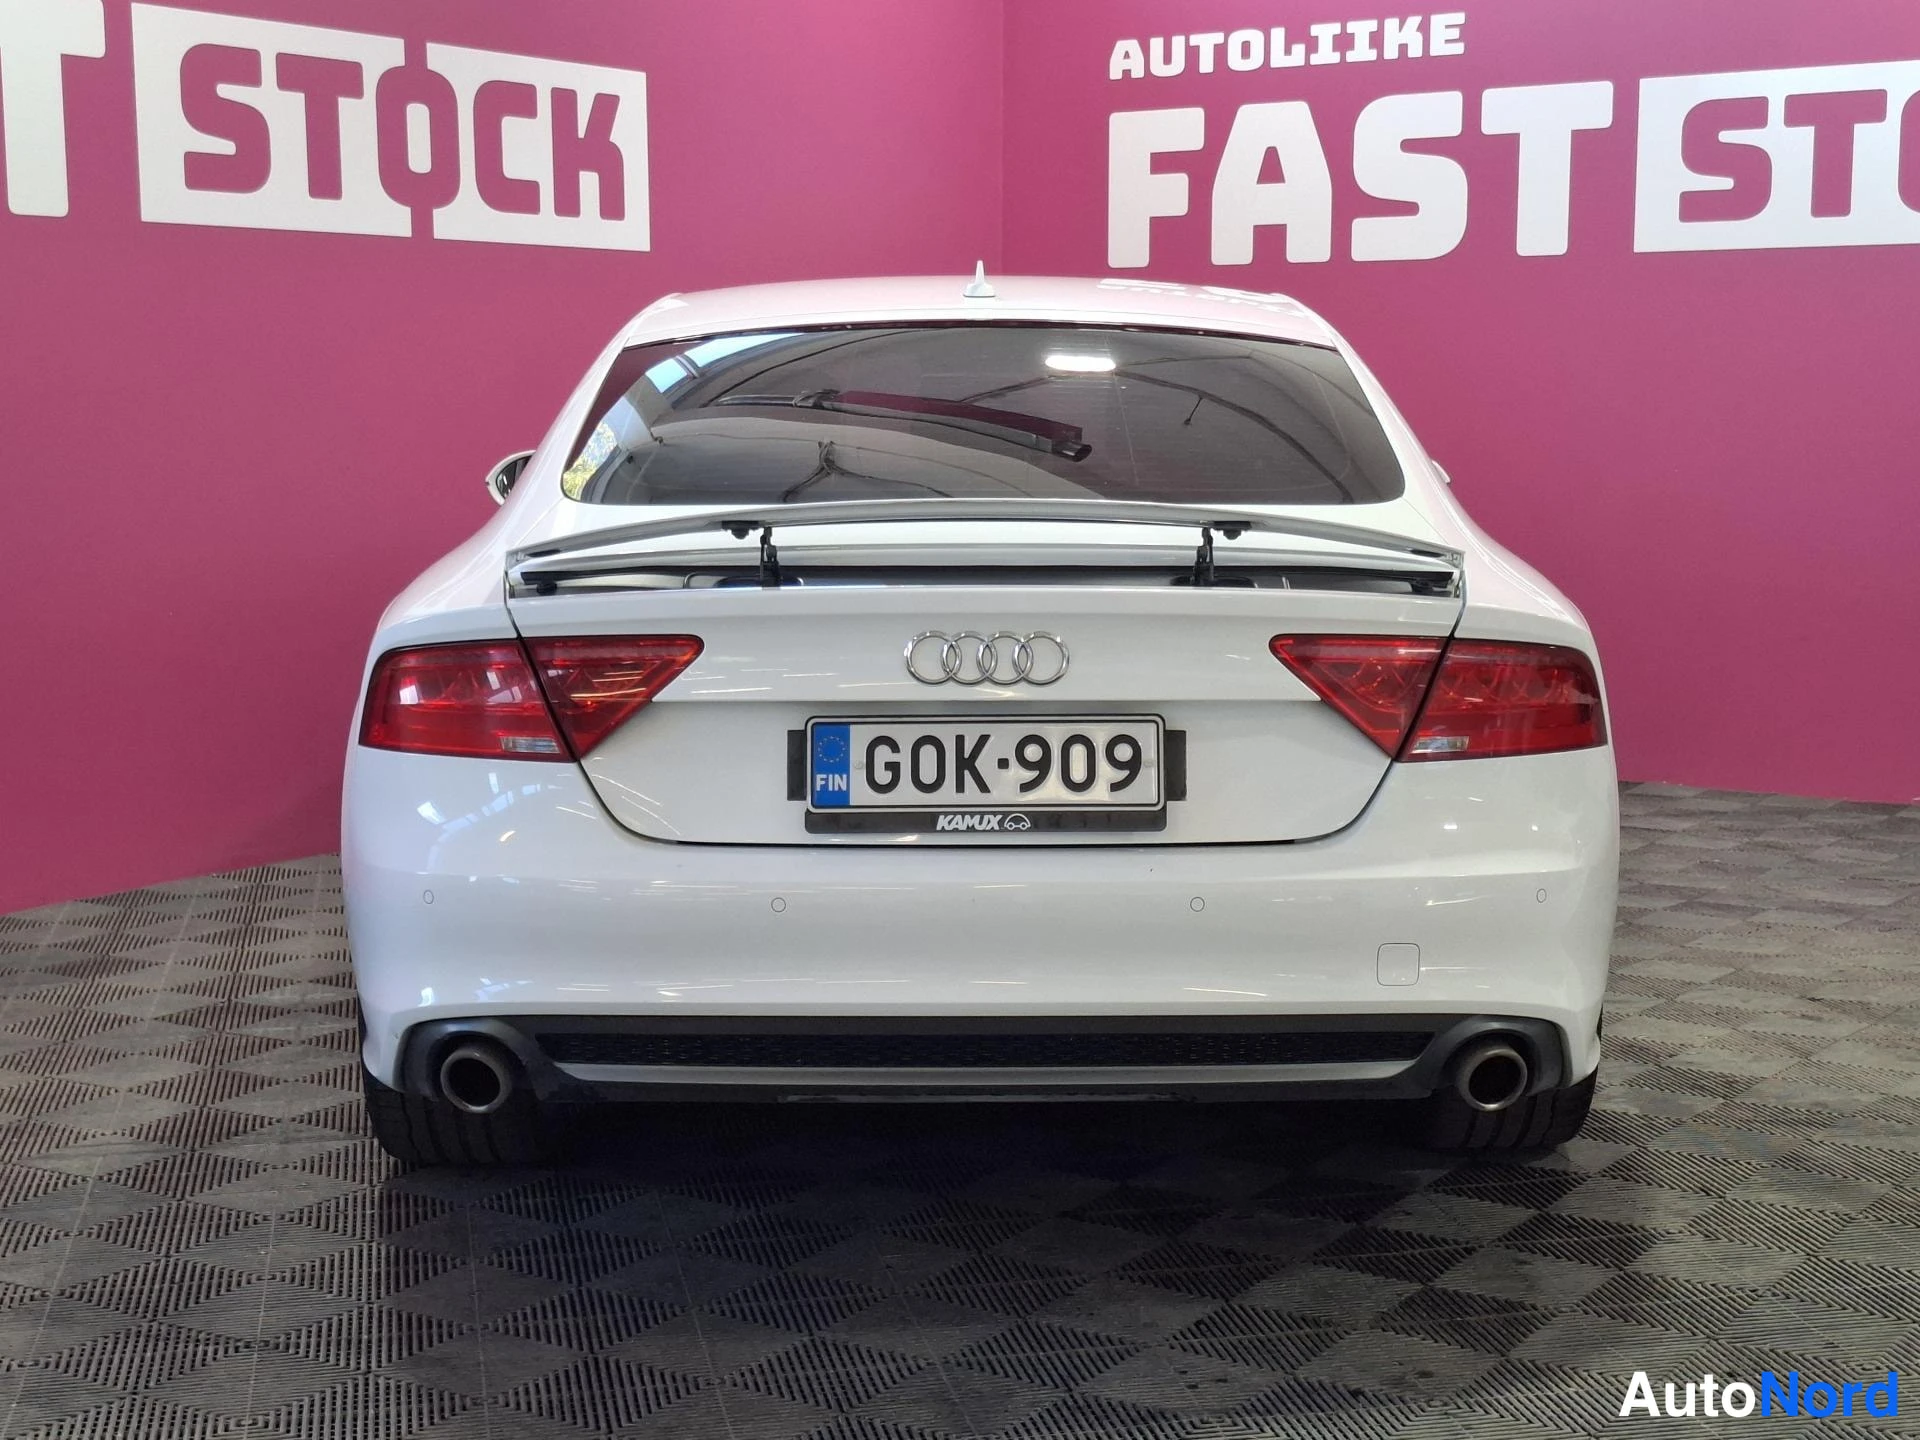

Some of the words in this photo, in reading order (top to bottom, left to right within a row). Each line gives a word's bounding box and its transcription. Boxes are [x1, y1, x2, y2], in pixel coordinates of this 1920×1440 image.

[1108, 12, 1466, 80] AUTOLIIKE
[179, 42, 626, 222] STOCK
[1107, 80, 1614, 268] FAST
[1678, 88, 1920, 223] ST
[815, 773, 847, 792] FIN
[865, 733, 1143, 794] GOK-909
[936, 814, 1003, 831] KAMUX
